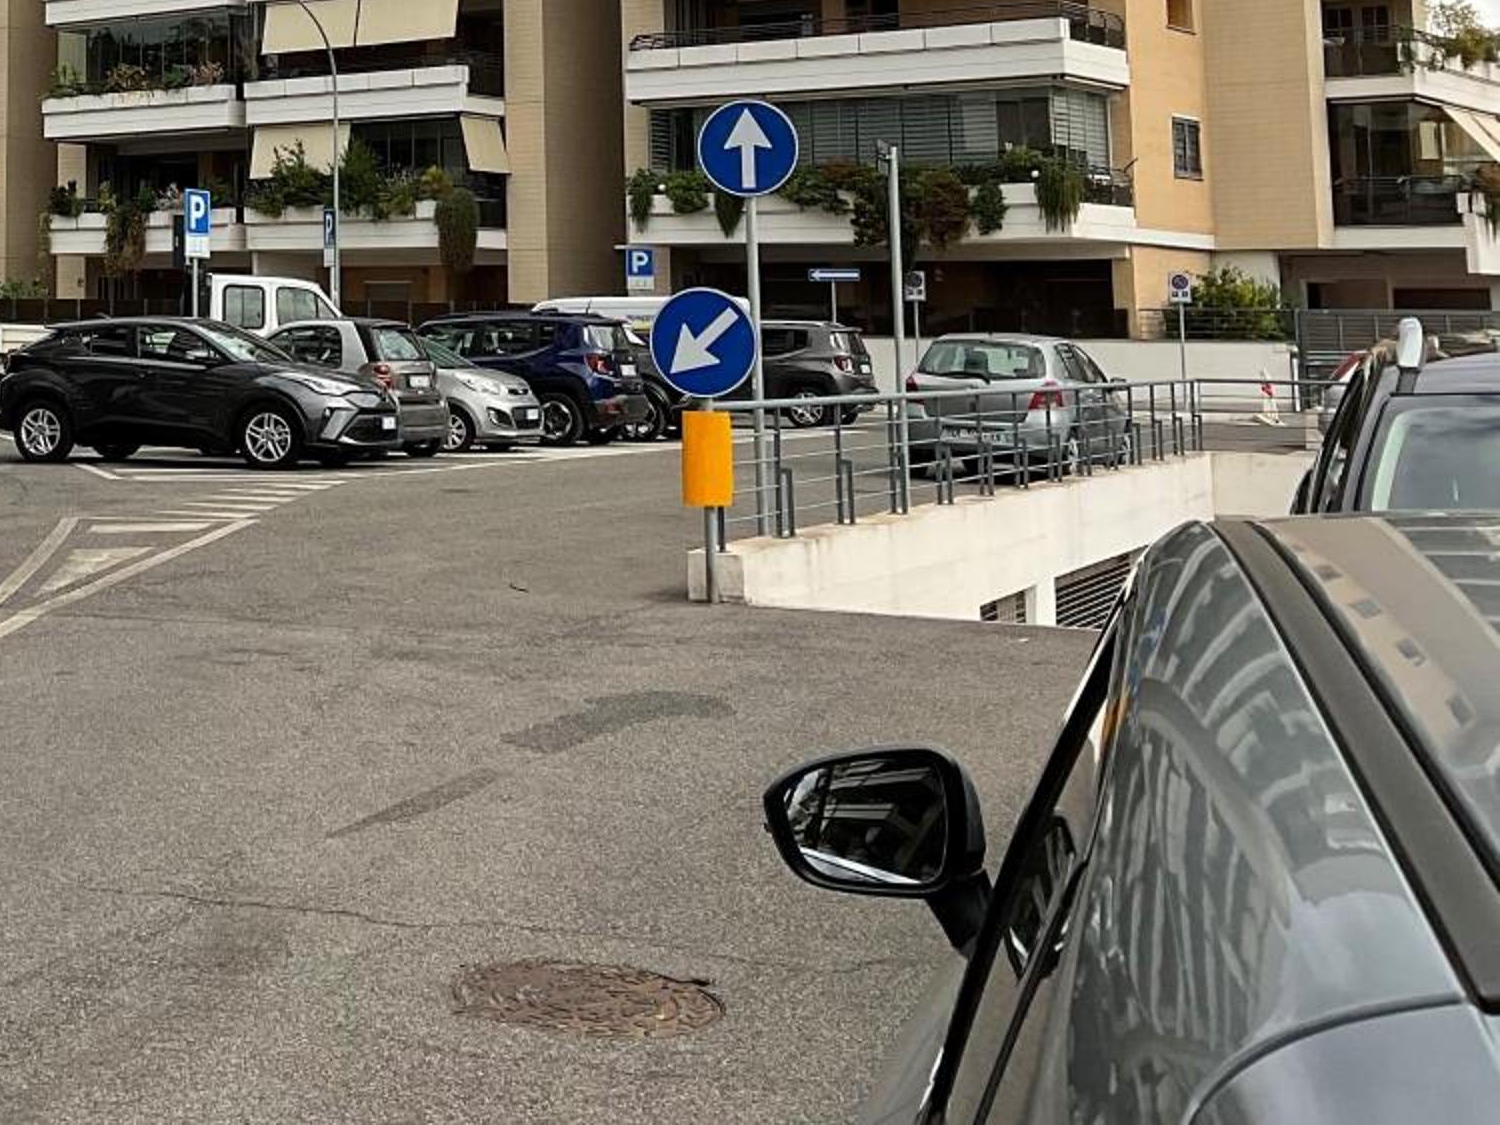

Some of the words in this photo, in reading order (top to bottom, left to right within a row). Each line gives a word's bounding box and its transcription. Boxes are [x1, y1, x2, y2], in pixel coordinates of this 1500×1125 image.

[190, 195, 204, 229] P
[325, 214, 332, 243] P
[632, 252, 648, 273] P
